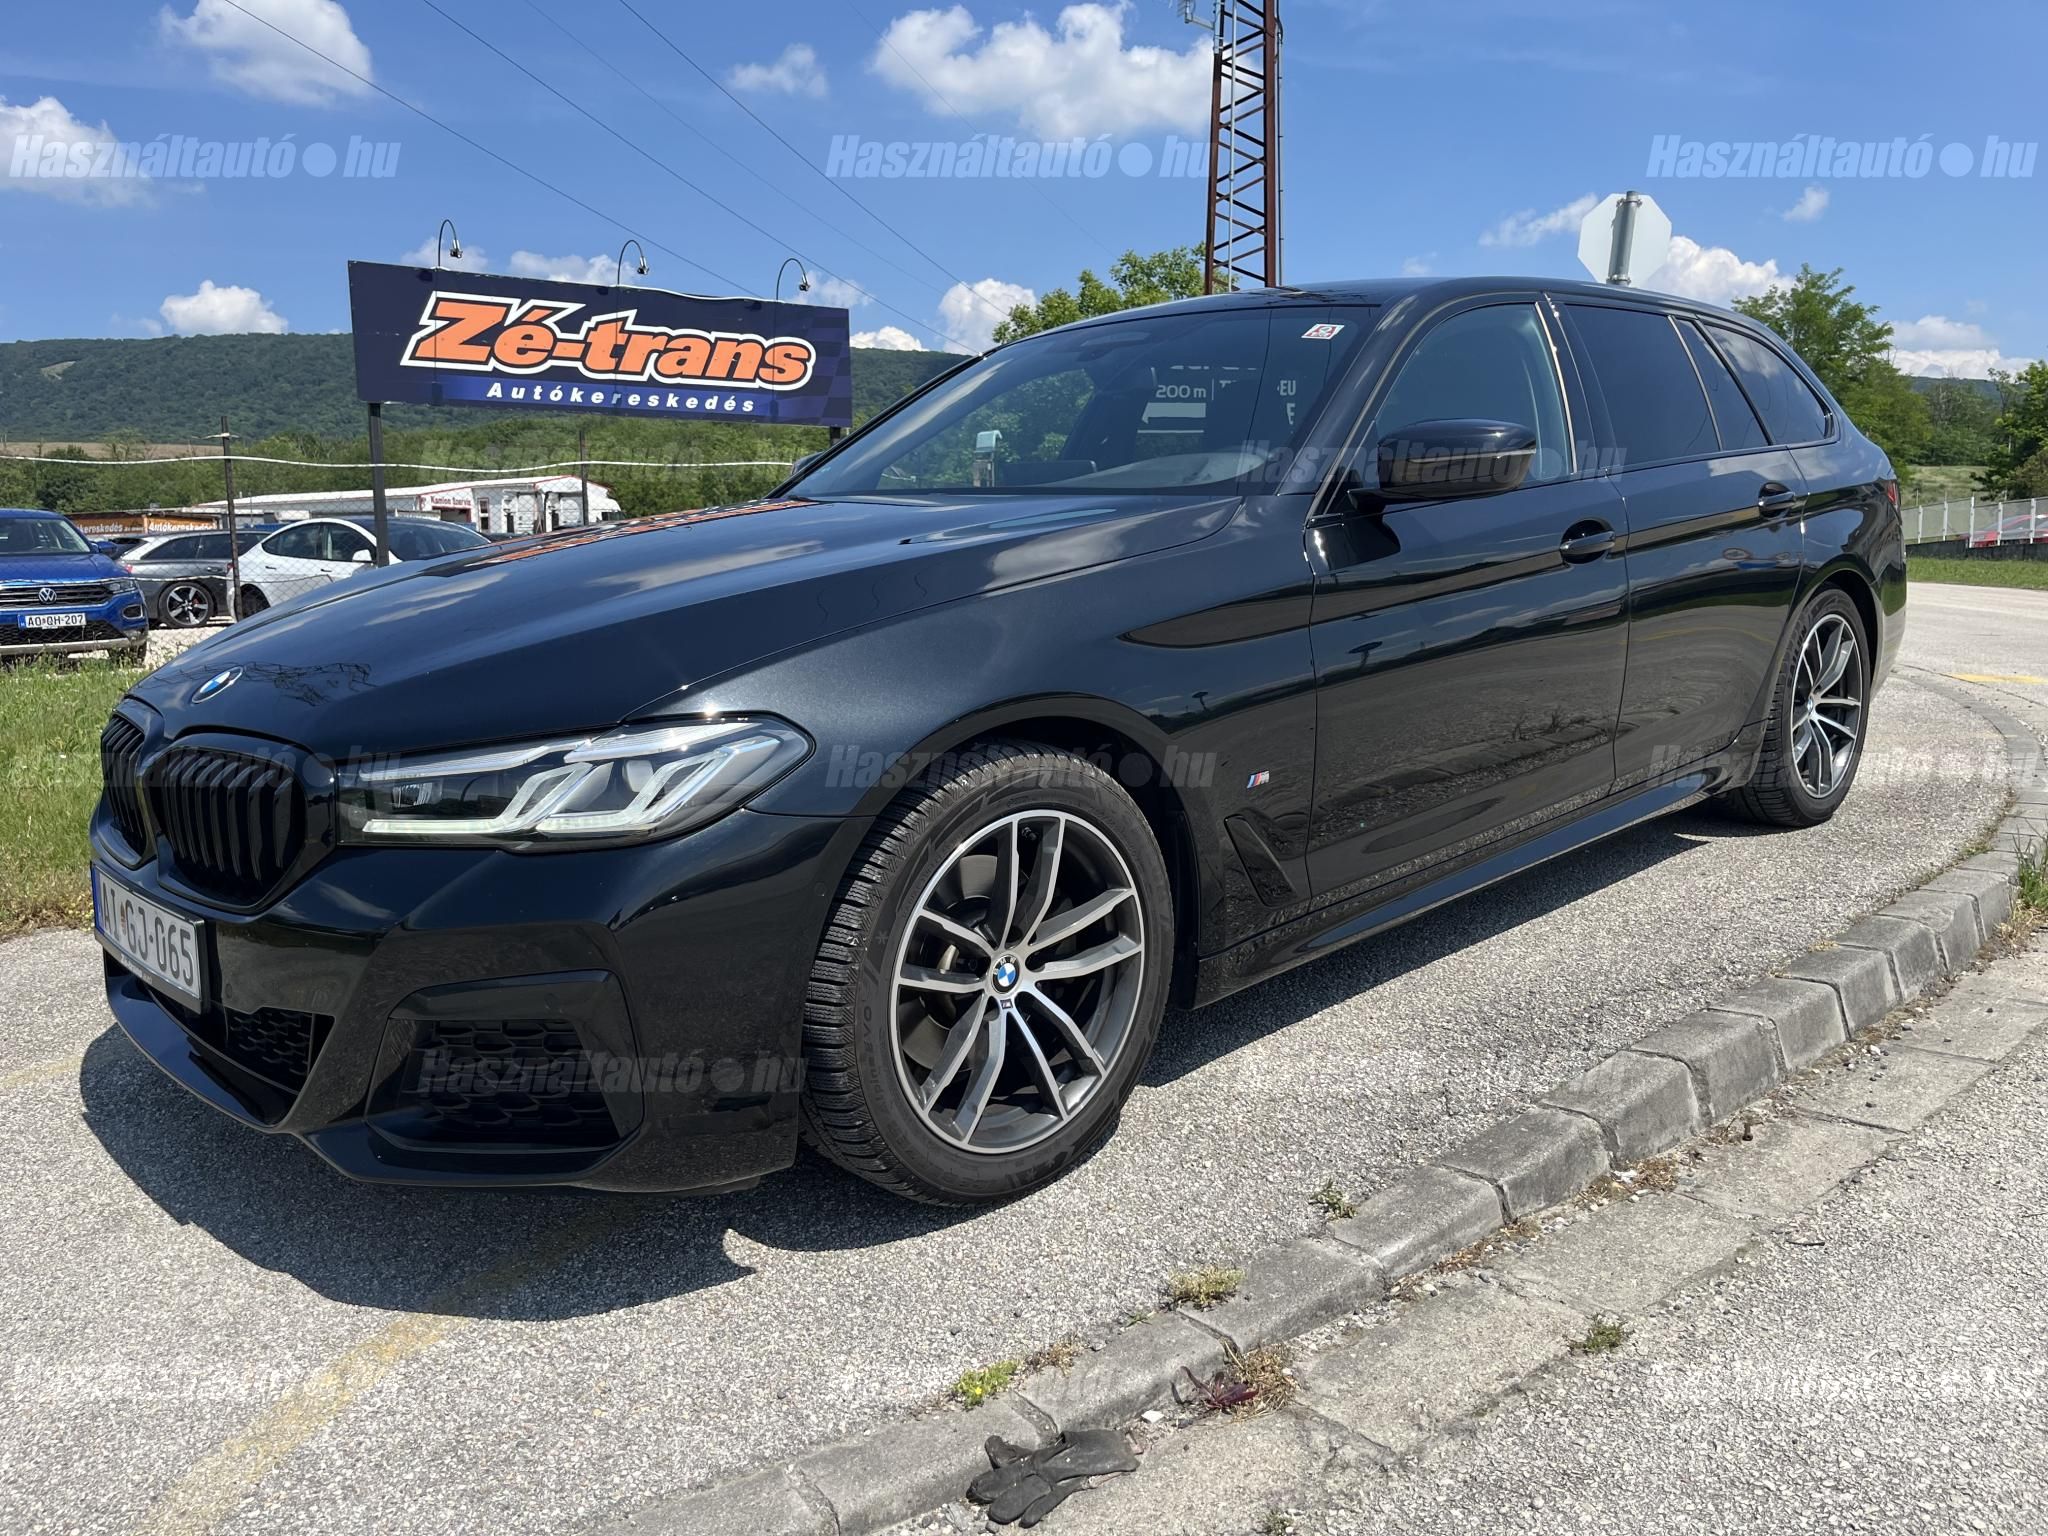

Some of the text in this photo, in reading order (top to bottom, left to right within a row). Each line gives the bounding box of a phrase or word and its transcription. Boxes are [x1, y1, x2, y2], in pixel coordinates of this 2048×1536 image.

[402, 292, 815, 389] Zé-trans
[486, 381, 756, 413] Autókereskedés
[1155, 384, 1207, 399] 200 m
